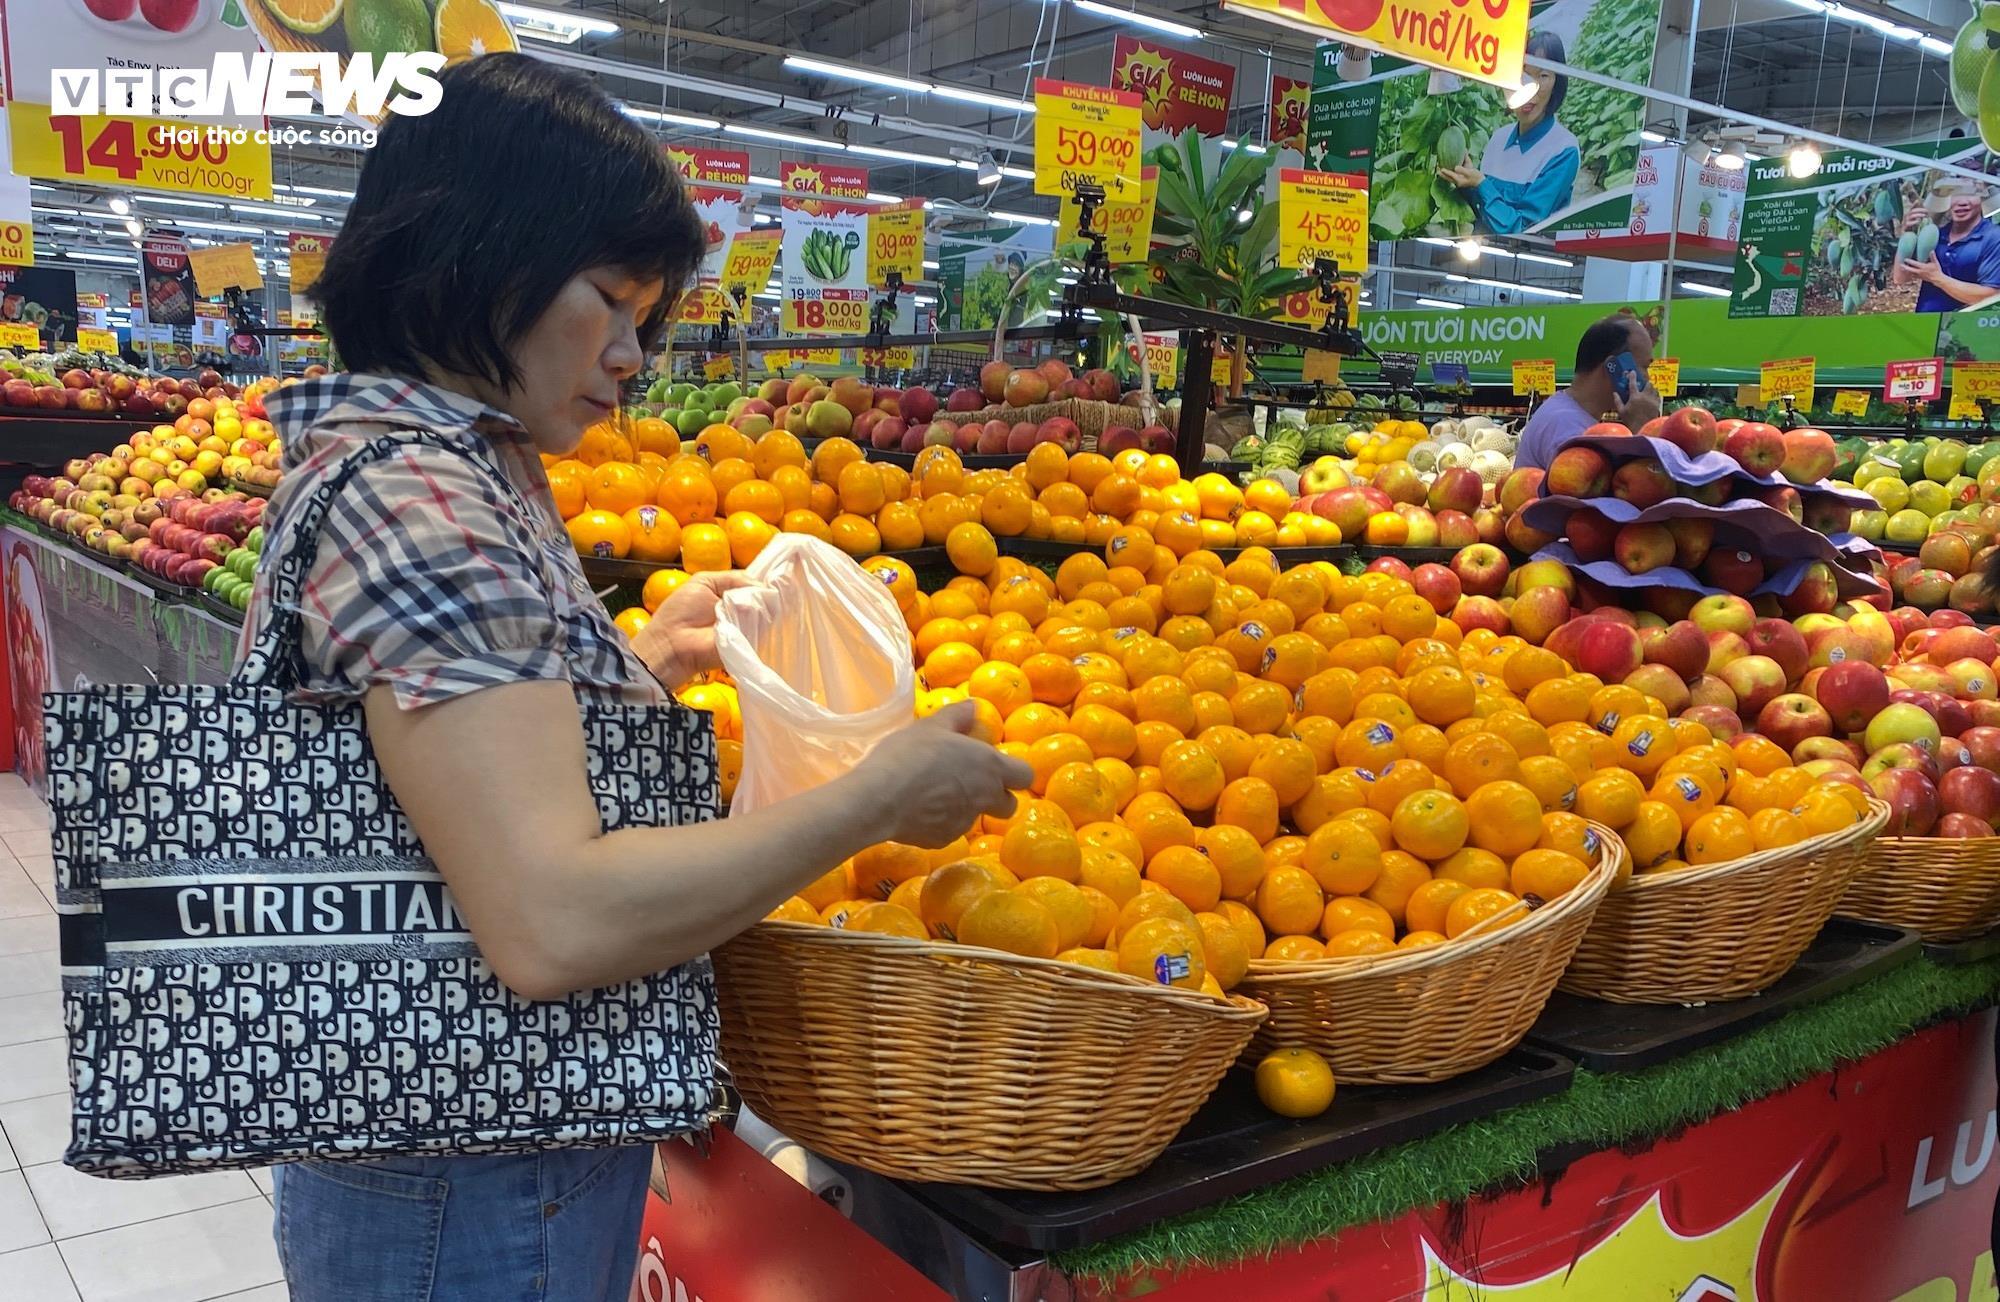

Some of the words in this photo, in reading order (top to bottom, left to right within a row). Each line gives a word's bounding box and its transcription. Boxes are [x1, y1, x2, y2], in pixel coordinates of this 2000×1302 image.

[1391, 5, 1500, 75] vnđ/kg
[1130, 61, 1166, 96] GIÁ
[1182, 69, 1203, 84] LUÔN
[1203, 74, 1223, 88] LUÔN
[1063, 85, 1101, 102] KHUYẾN
[1179, 84, 1197, 103] RẺ
[1199, 92, 1227, 112] HƠN
[1056, 126, 1135, 166] 59.000
[152, 167, 255, 195] vnd/100gr
[1297, 209, 1361, 244] 45.000
[792, 300, 863, 329] 18.000
[826, 317, 861, 330] vnd/kg
[1359, 315, 1407, 344] UÔN
[1411, 315, 1465, 344] TƯƠI
[1470, 315, 1546, 342] NGON
[1425, 349, 1504, 365] EVERYDAY
[177, 883, 470, 936] CHRISTIAN
